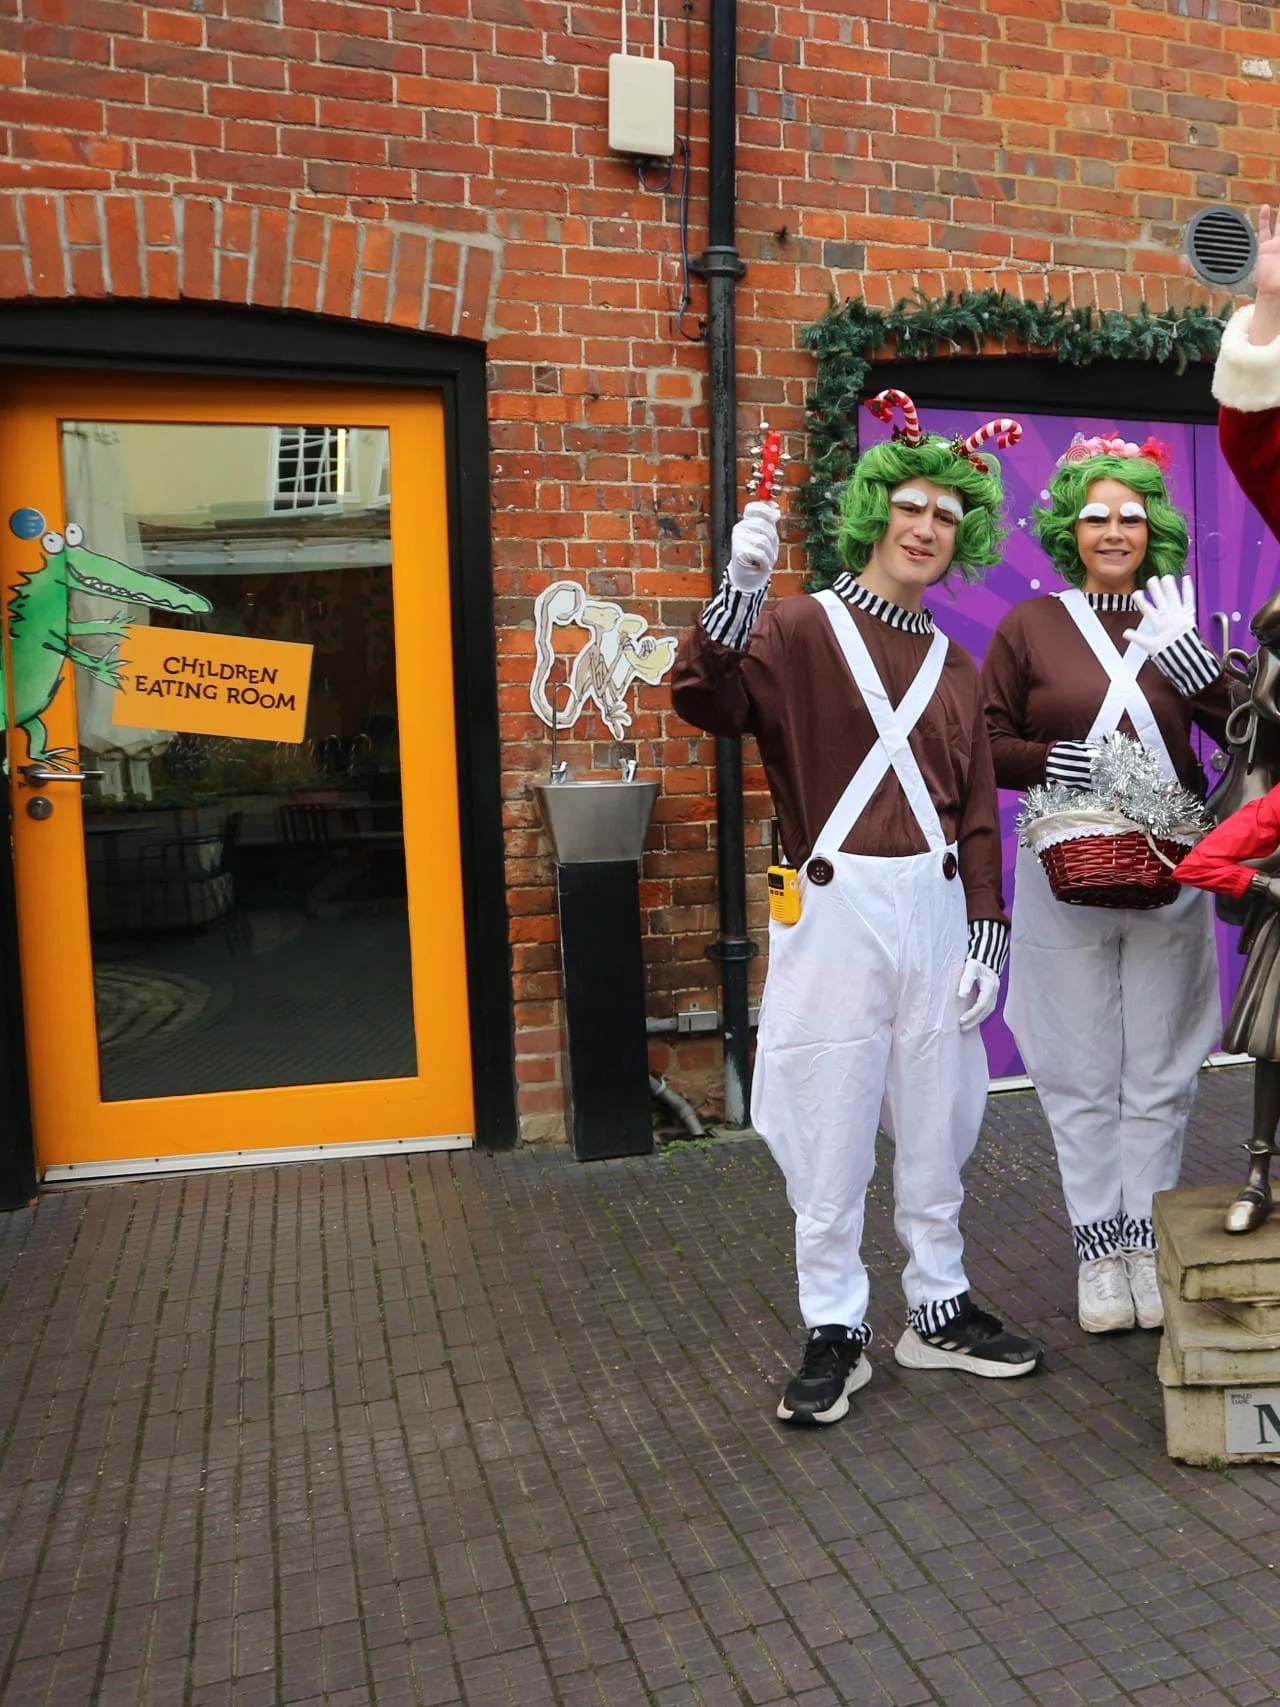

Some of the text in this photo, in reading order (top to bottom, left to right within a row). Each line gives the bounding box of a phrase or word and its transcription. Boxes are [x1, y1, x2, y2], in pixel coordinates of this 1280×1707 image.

[163, 656, 279, 684] CHILDREN
[135, 675, 296, 711] EATING ROOM
